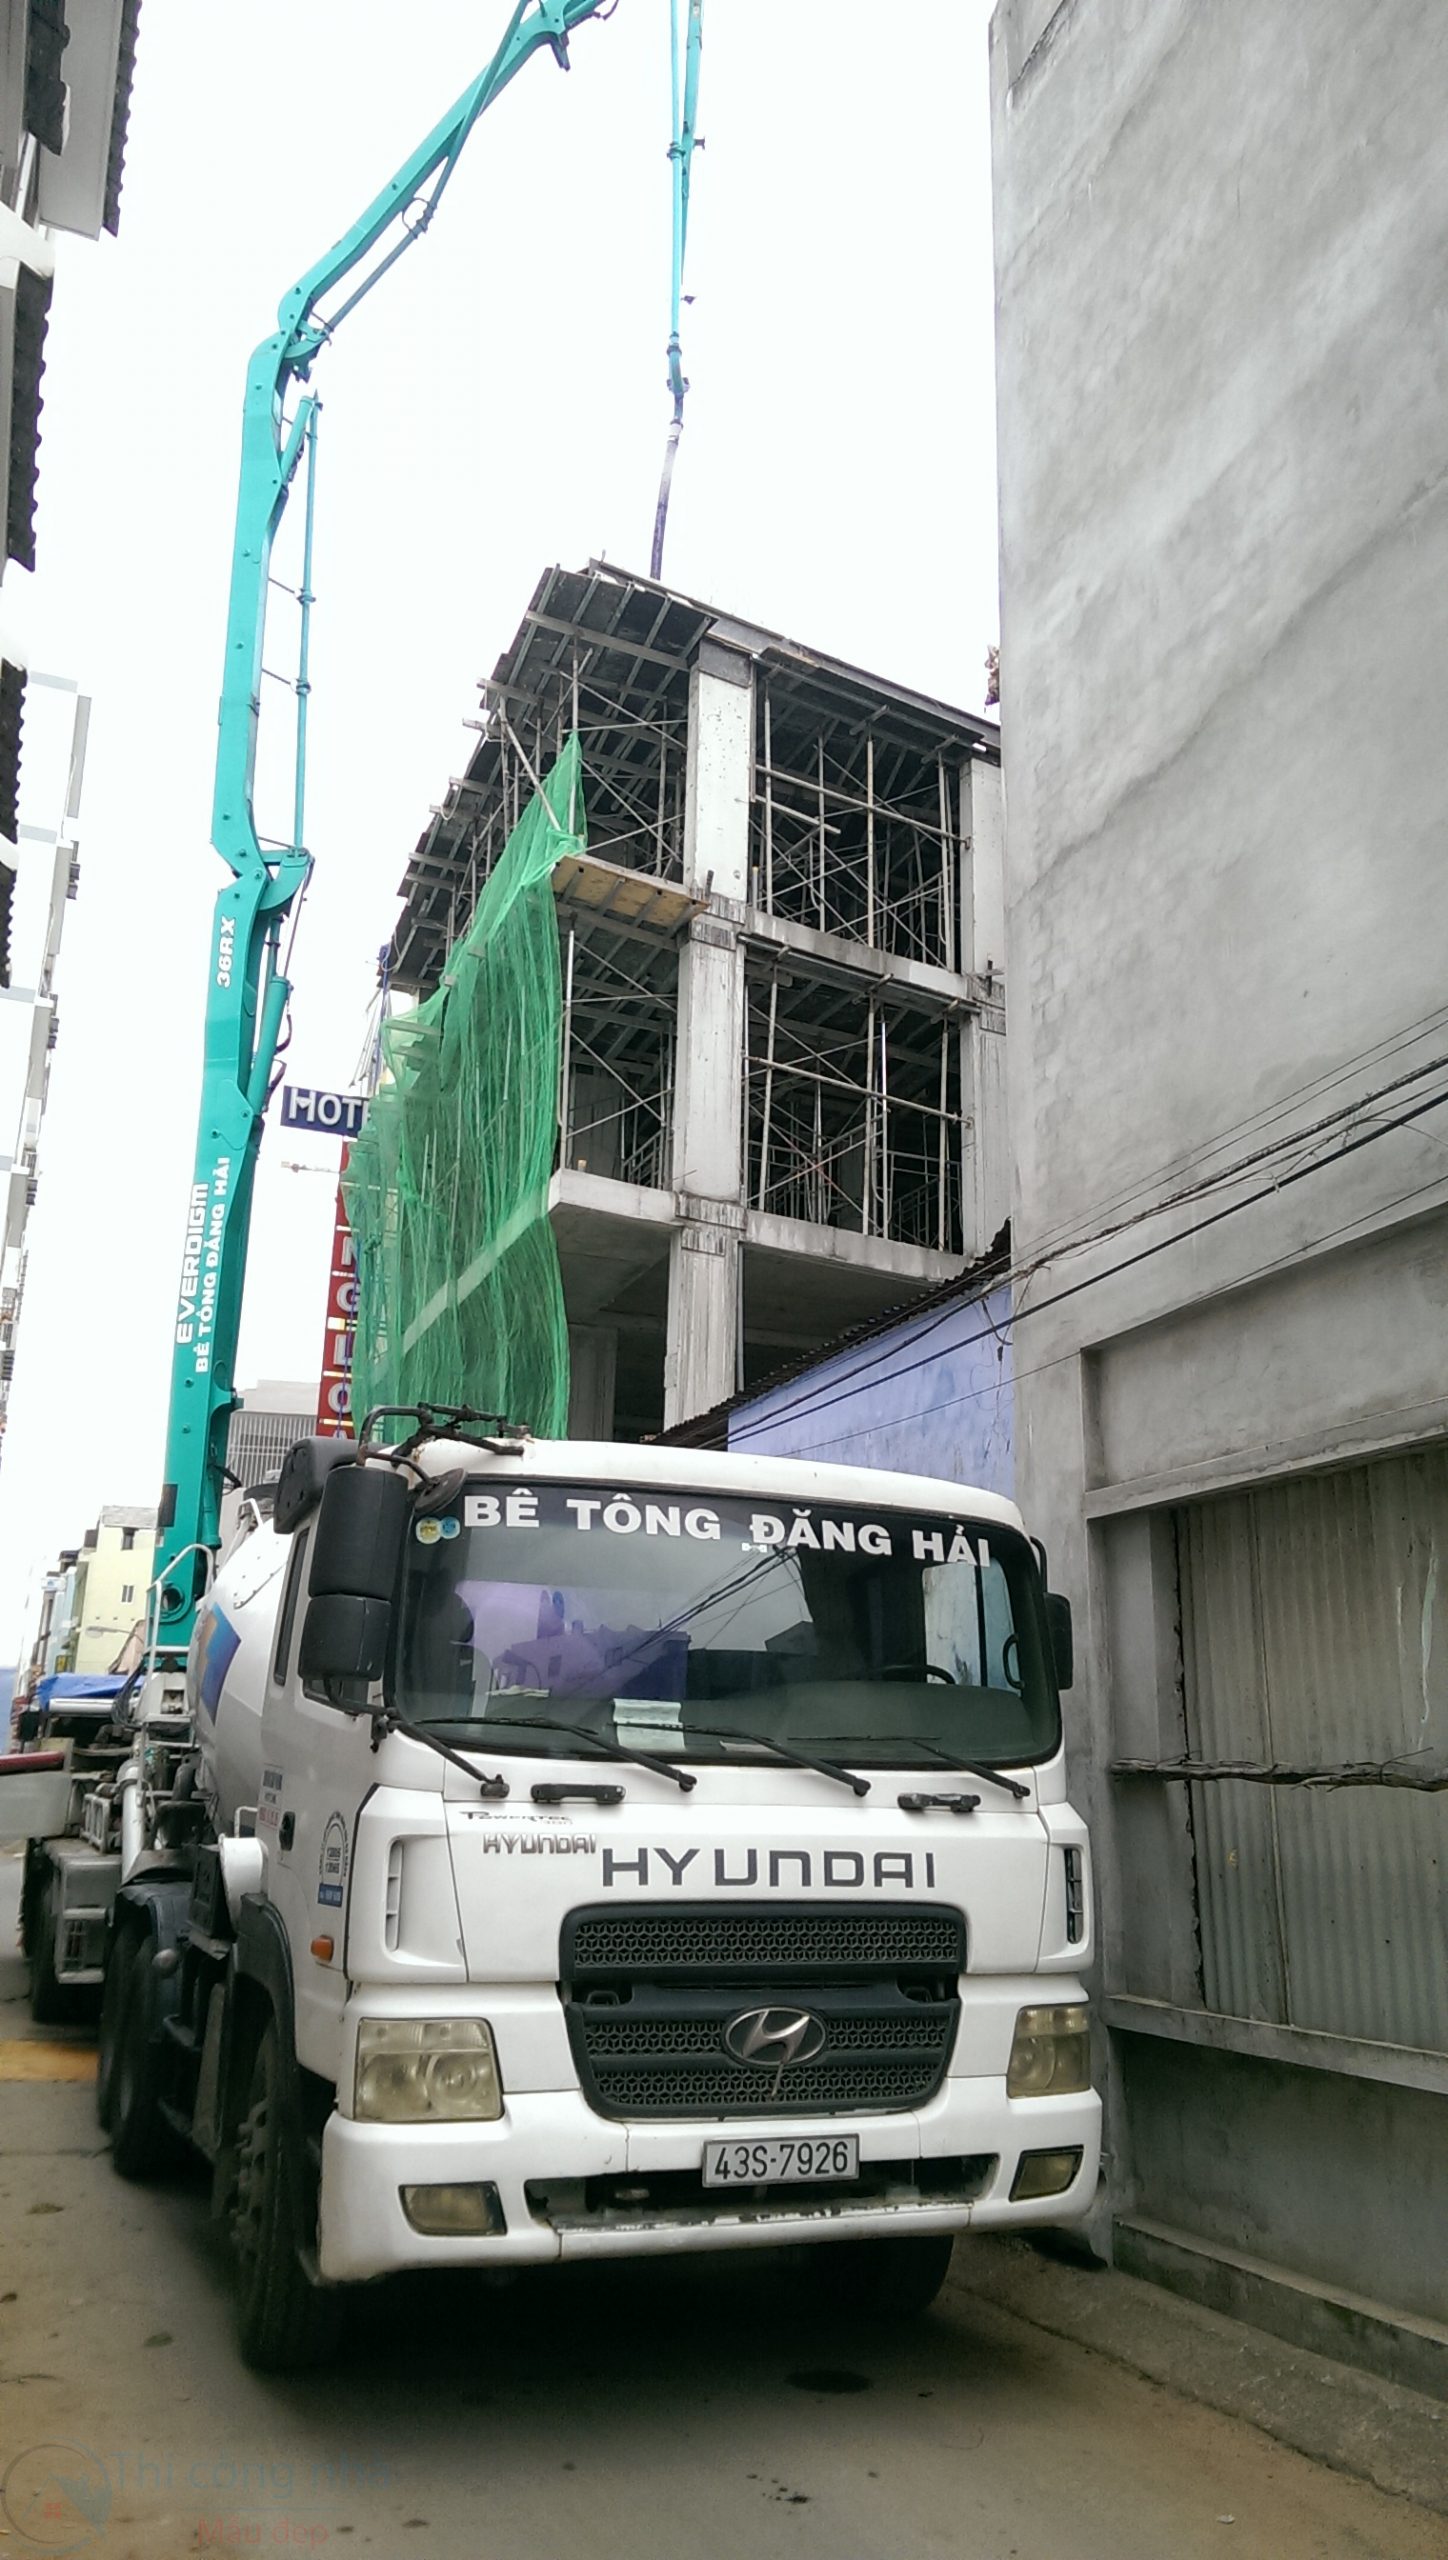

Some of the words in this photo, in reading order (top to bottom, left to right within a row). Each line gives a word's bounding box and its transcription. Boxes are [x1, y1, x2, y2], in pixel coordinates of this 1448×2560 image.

[216, 915, 236, 988] 36RX
[177, 1183, 209, 1344] EVERDIGM
[196, 1272, 217, 1337] TÔNG
[465, 1488, 540, 1528] BÊ
[566, 1494, 720, 1541] TÔNG
[750, 1509, 893, 1556] ĐĂNG
[912, 1525, 990, 1568] HẢI
[483, 1833, 596, 1854] HYUNDAI
[603, 1848, 935, 1889] HYUNDAI
[714, 2141, 848, 2180] 43S-7926
